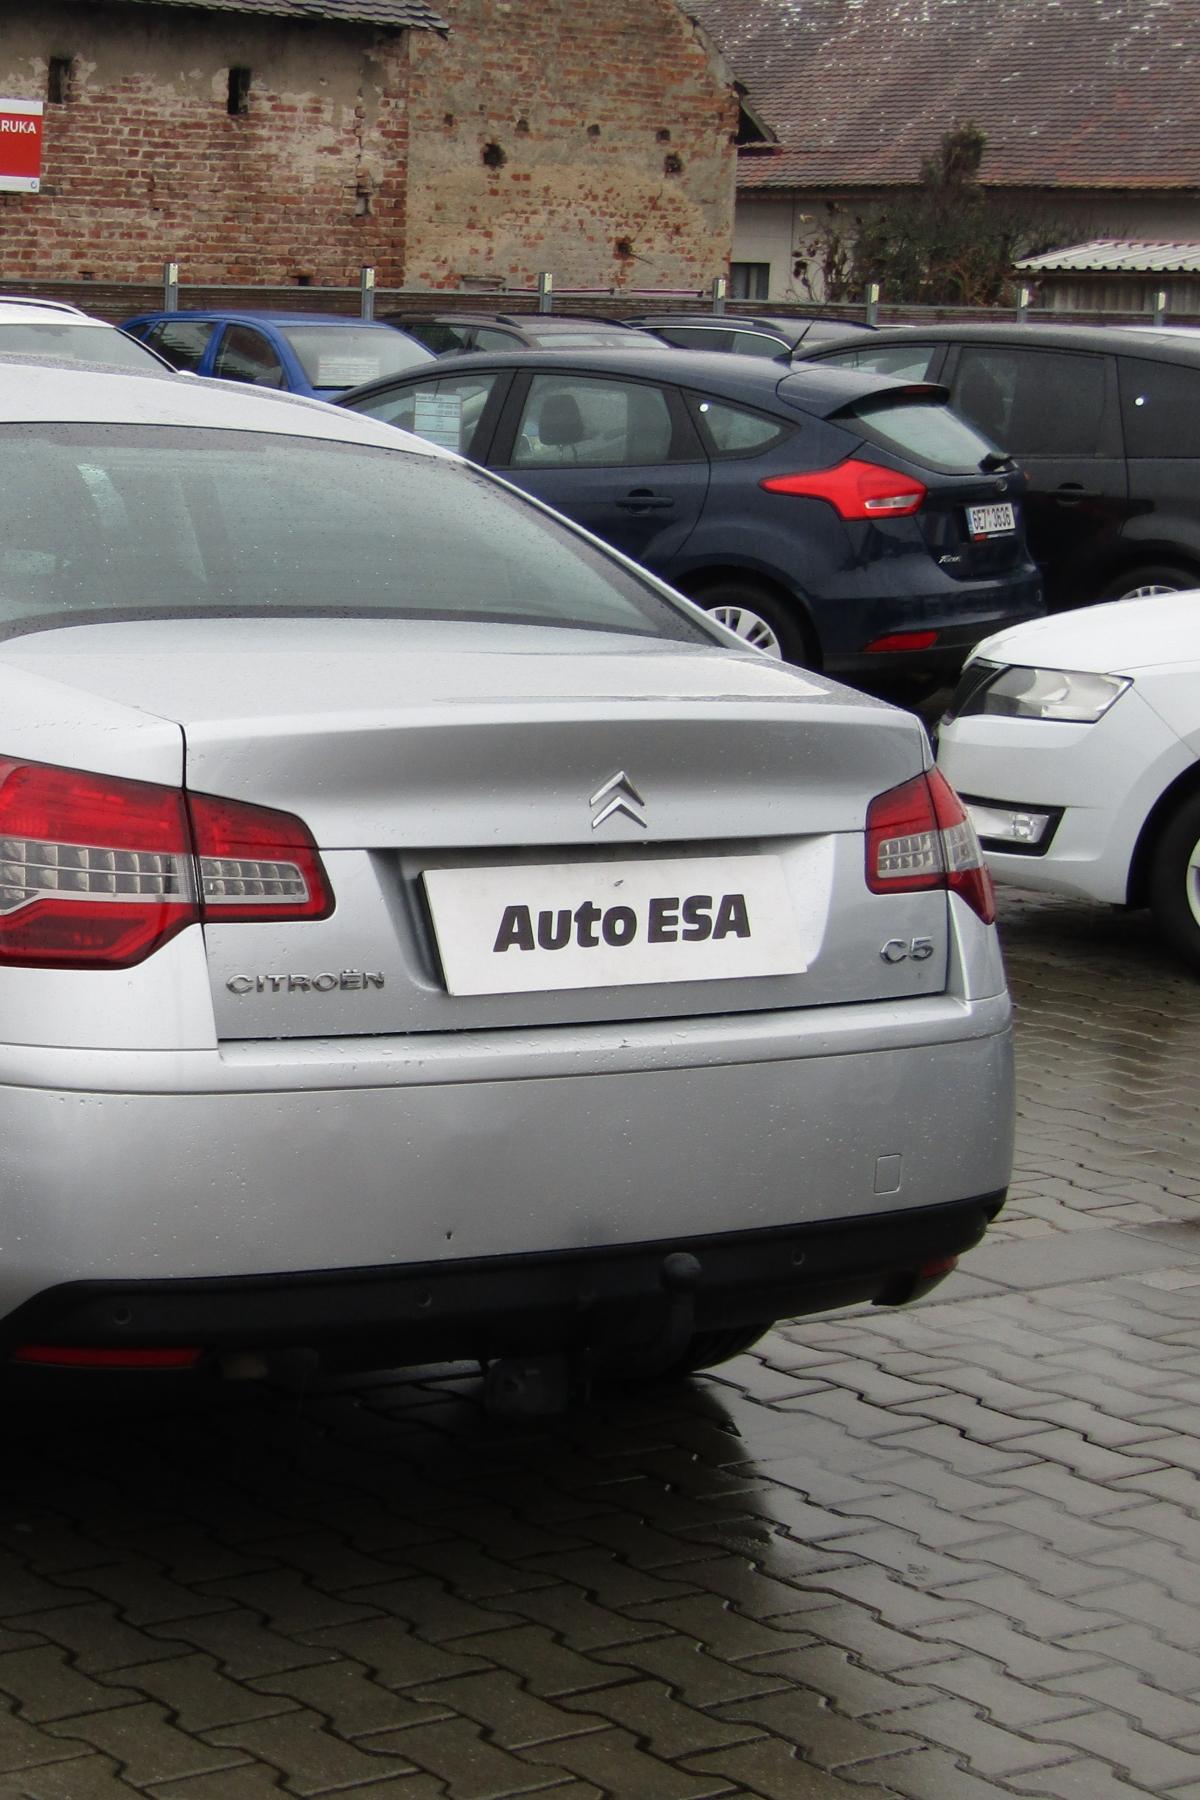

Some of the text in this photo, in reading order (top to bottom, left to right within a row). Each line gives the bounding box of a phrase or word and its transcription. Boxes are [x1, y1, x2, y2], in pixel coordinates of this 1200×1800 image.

[493, 893, 751, 952] Auto ESA
[880, 935, 934, 965] C5
[225, 968, 385, 994] CITROËN
